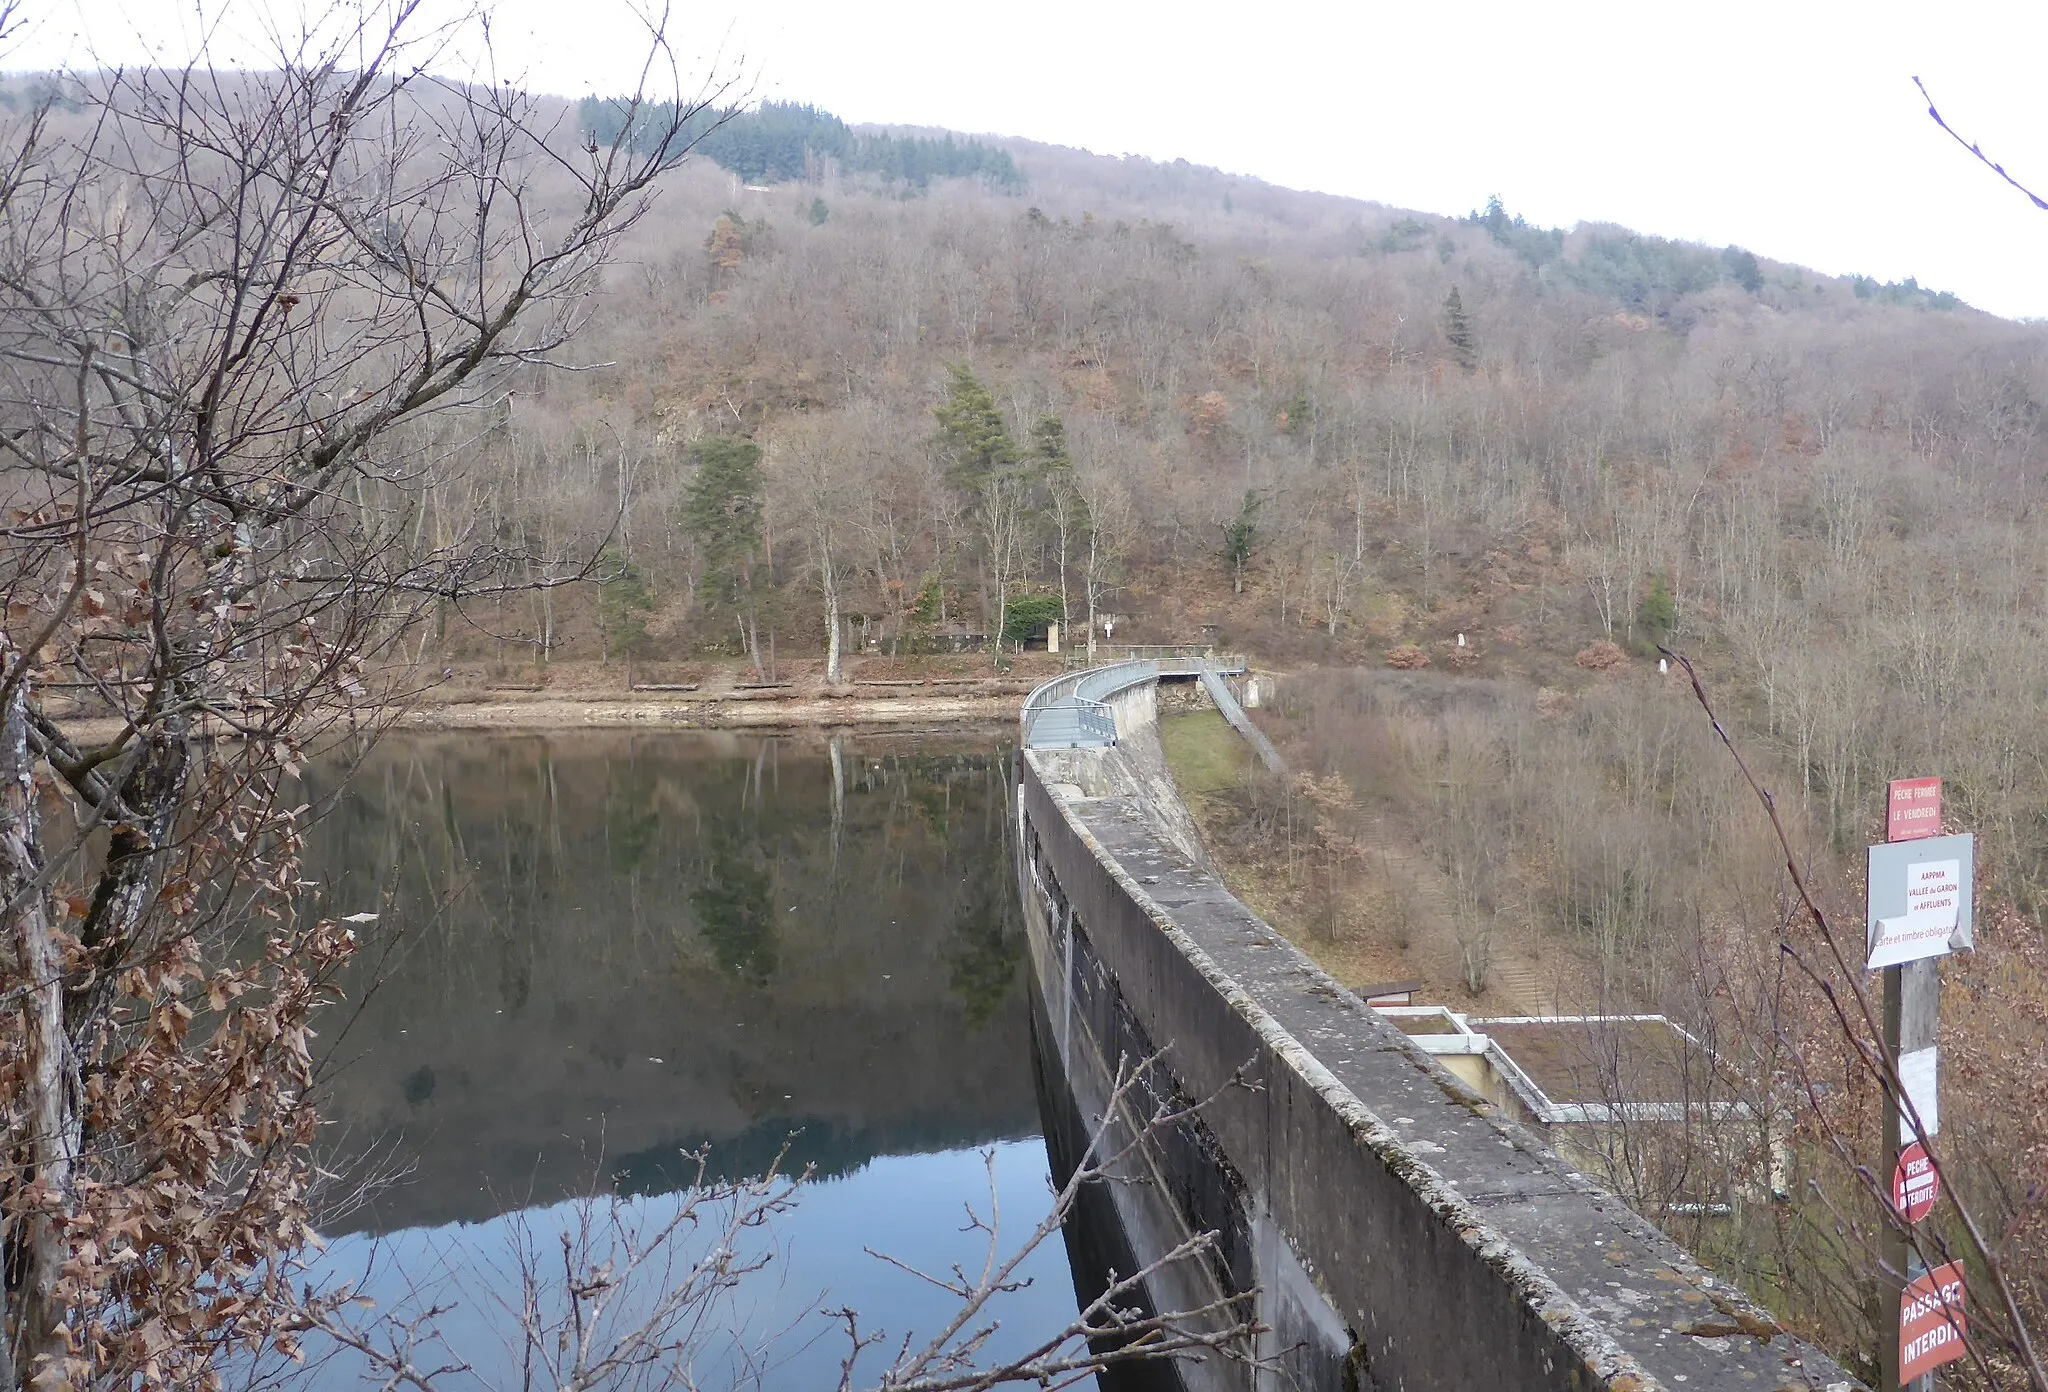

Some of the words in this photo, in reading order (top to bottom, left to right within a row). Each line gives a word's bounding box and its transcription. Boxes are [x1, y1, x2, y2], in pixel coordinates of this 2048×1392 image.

[1893, 810, 1901, 821] LE
[1904, 807, 1936, 819] VENDREDI
[1921, 870, 1945, 880] AAPPMA
[1937, 884, 1957, 893] GARON
[1919, 898, 1951, 910] AFFLUENTS
[1894, 934, 1901, 943] et
[1902, 929, 1924, 942] timbre
[1907, 1156, 1929, 1177] PECHE
[1899, 1186, 1934, 1210] INTERDITE
[1903, 1281, 1960, 1327] PASSAGE
